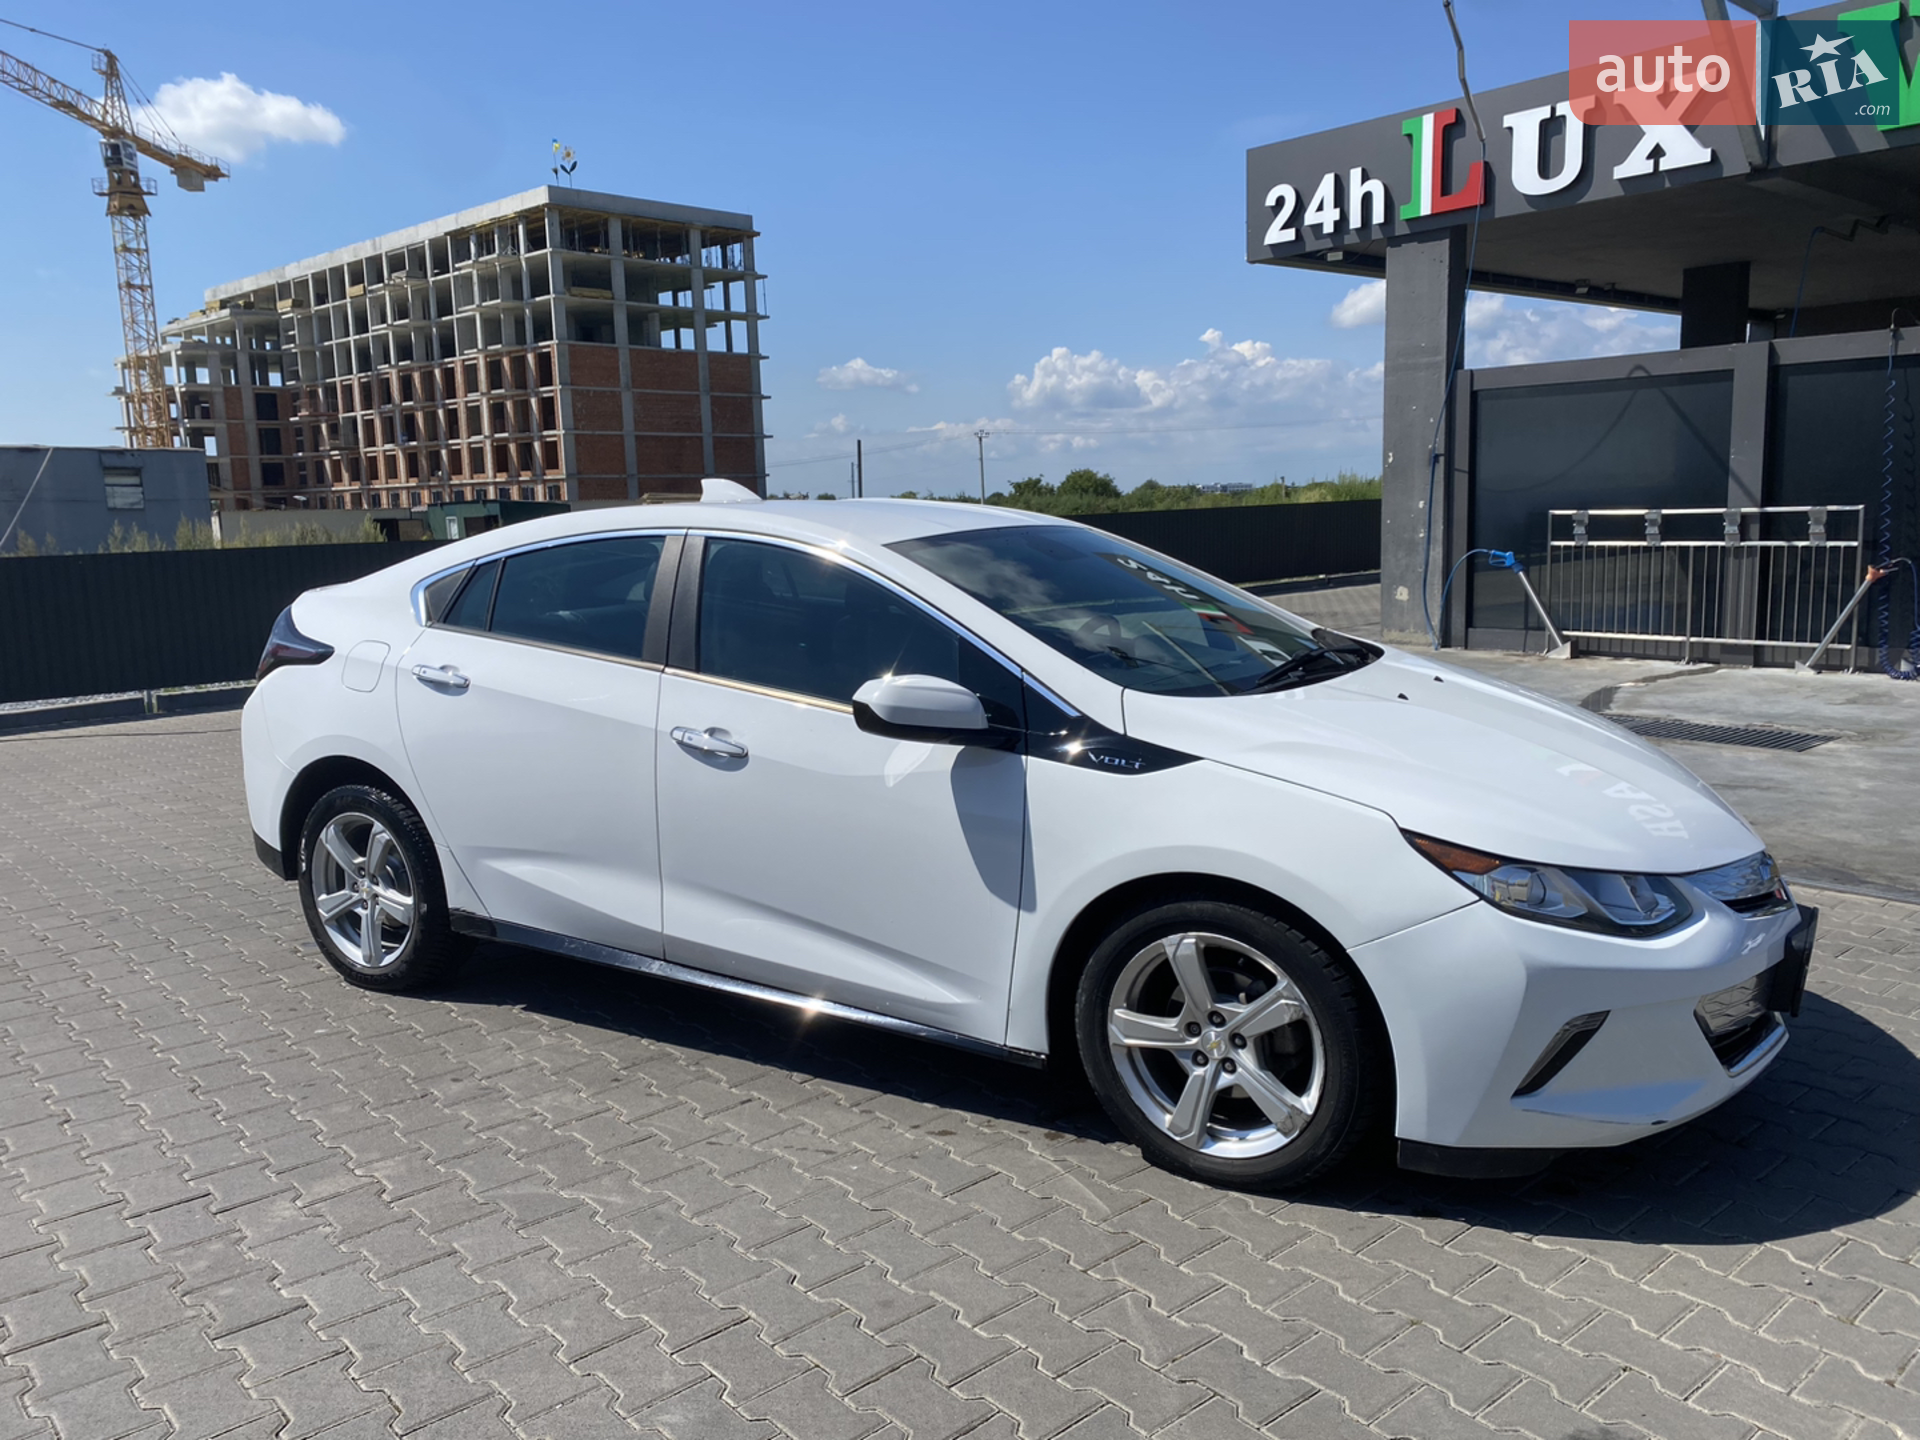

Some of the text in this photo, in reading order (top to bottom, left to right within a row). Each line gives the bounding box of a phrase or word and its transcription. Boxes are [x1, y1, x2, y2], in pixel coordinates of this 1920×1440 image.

[1263, 67, 1718, 246] 24h LUX
[1087, 750, 1146, 770] VOLT
